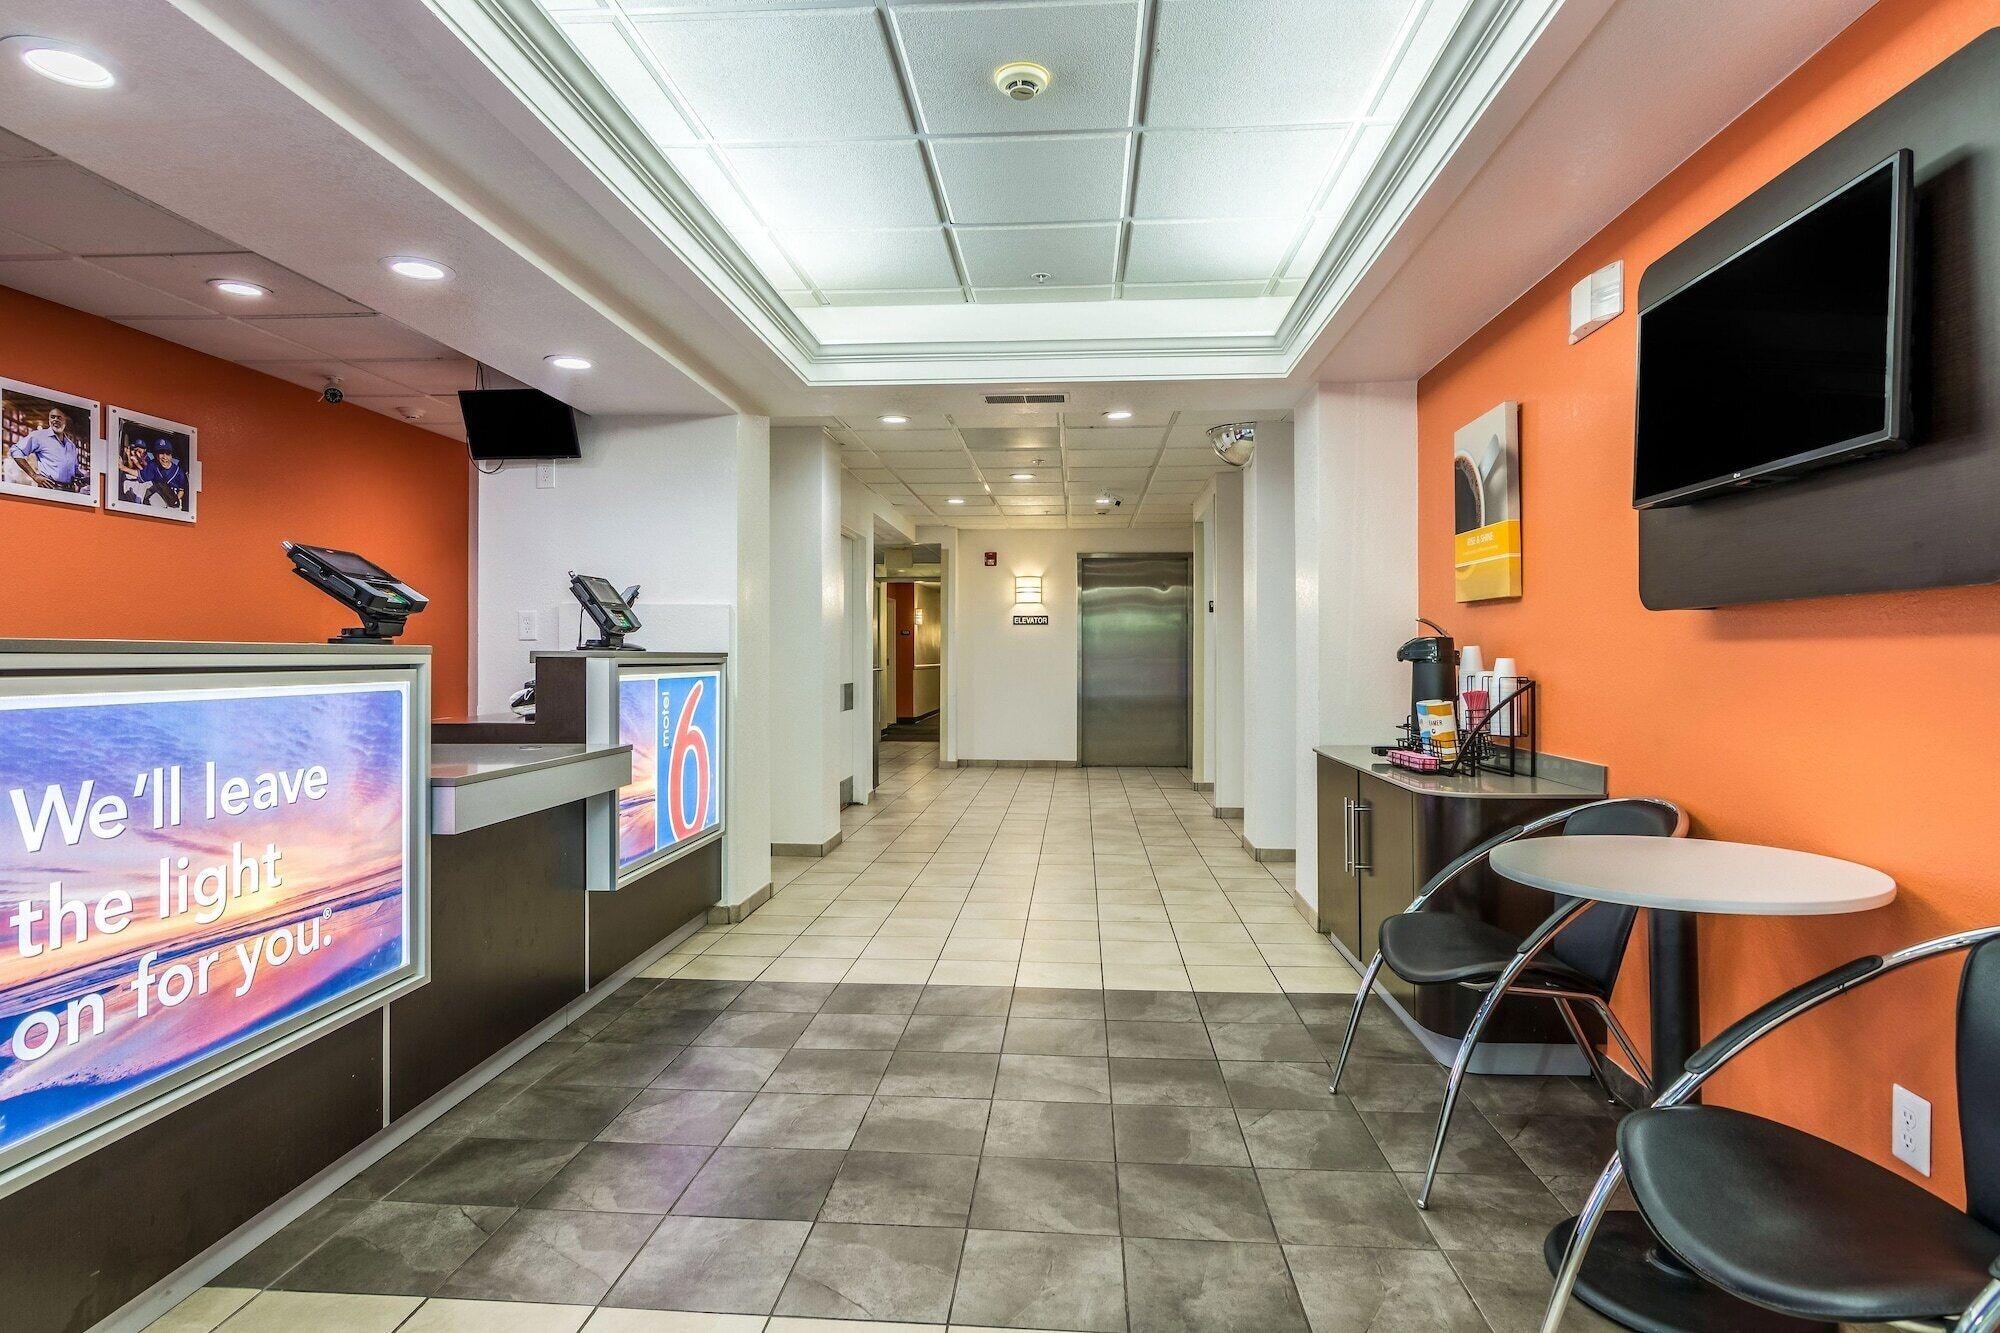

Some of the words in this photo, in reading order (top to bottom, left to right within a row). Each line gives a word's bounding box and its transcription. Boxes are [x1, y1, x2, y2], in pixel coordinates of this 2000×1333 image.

[1014, 616, 1047, 624] ELEVATOR
[206, 761, 329, 820] leave
[661, 691, 671, 749] motel
[667, 679, 711, 843] 6
[9, 881, 134, 959] the
[158, 840, 284, 924] light
[11, 992, 106, 1062] on
[130, 951, 220, 1019] for
